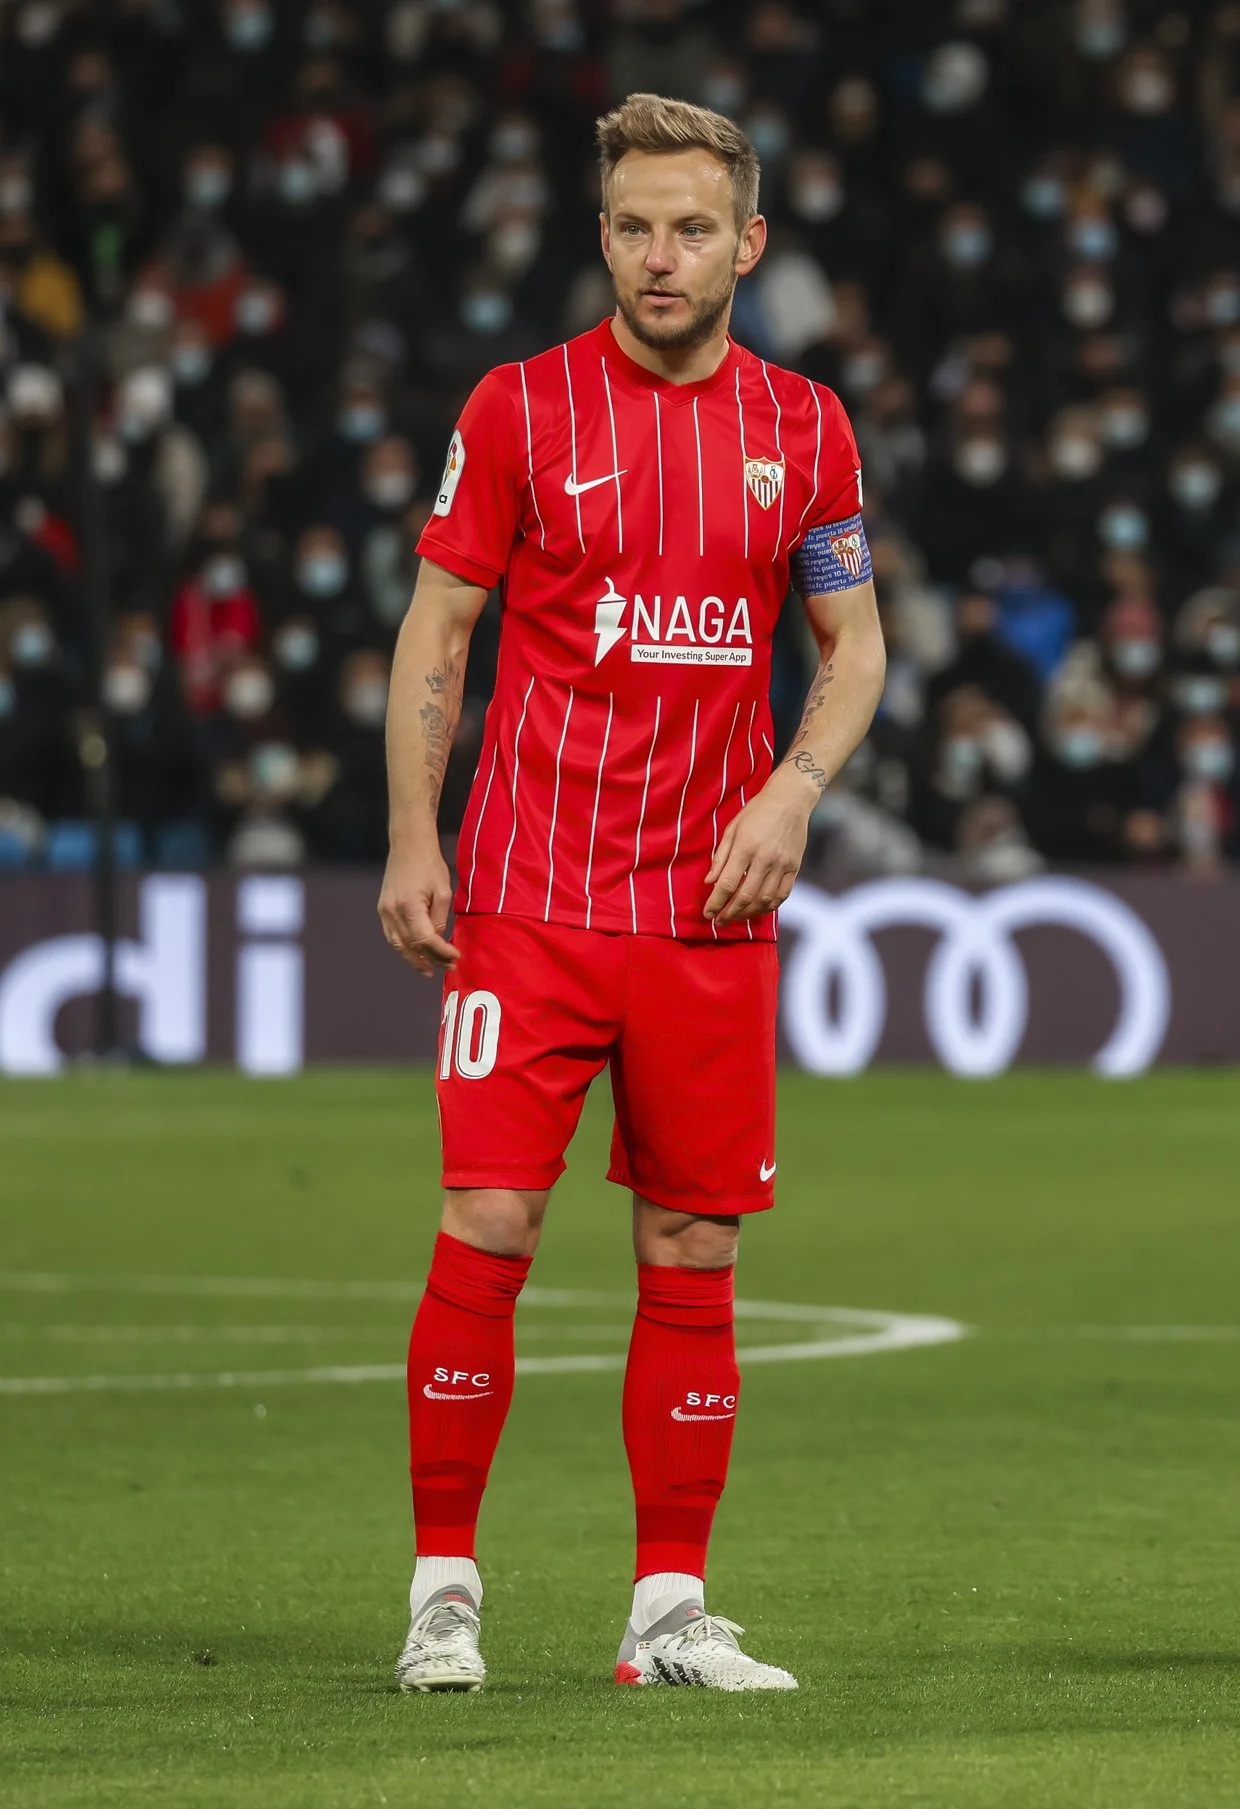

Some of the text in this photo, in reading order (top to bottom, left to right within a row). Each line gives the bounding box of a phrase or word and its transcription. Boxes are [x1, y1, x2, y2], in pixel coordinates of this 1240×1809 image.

[824, 578, 847, 589] puerta
[631, 594, 753, 644] NAGA
[637, 649, 747, 663] Your Investing Super App
[440, 990, 502, 1080] 10
[434, 1367, 490, 1387] SFC
[686, 1391, 736, 1409] SFC
